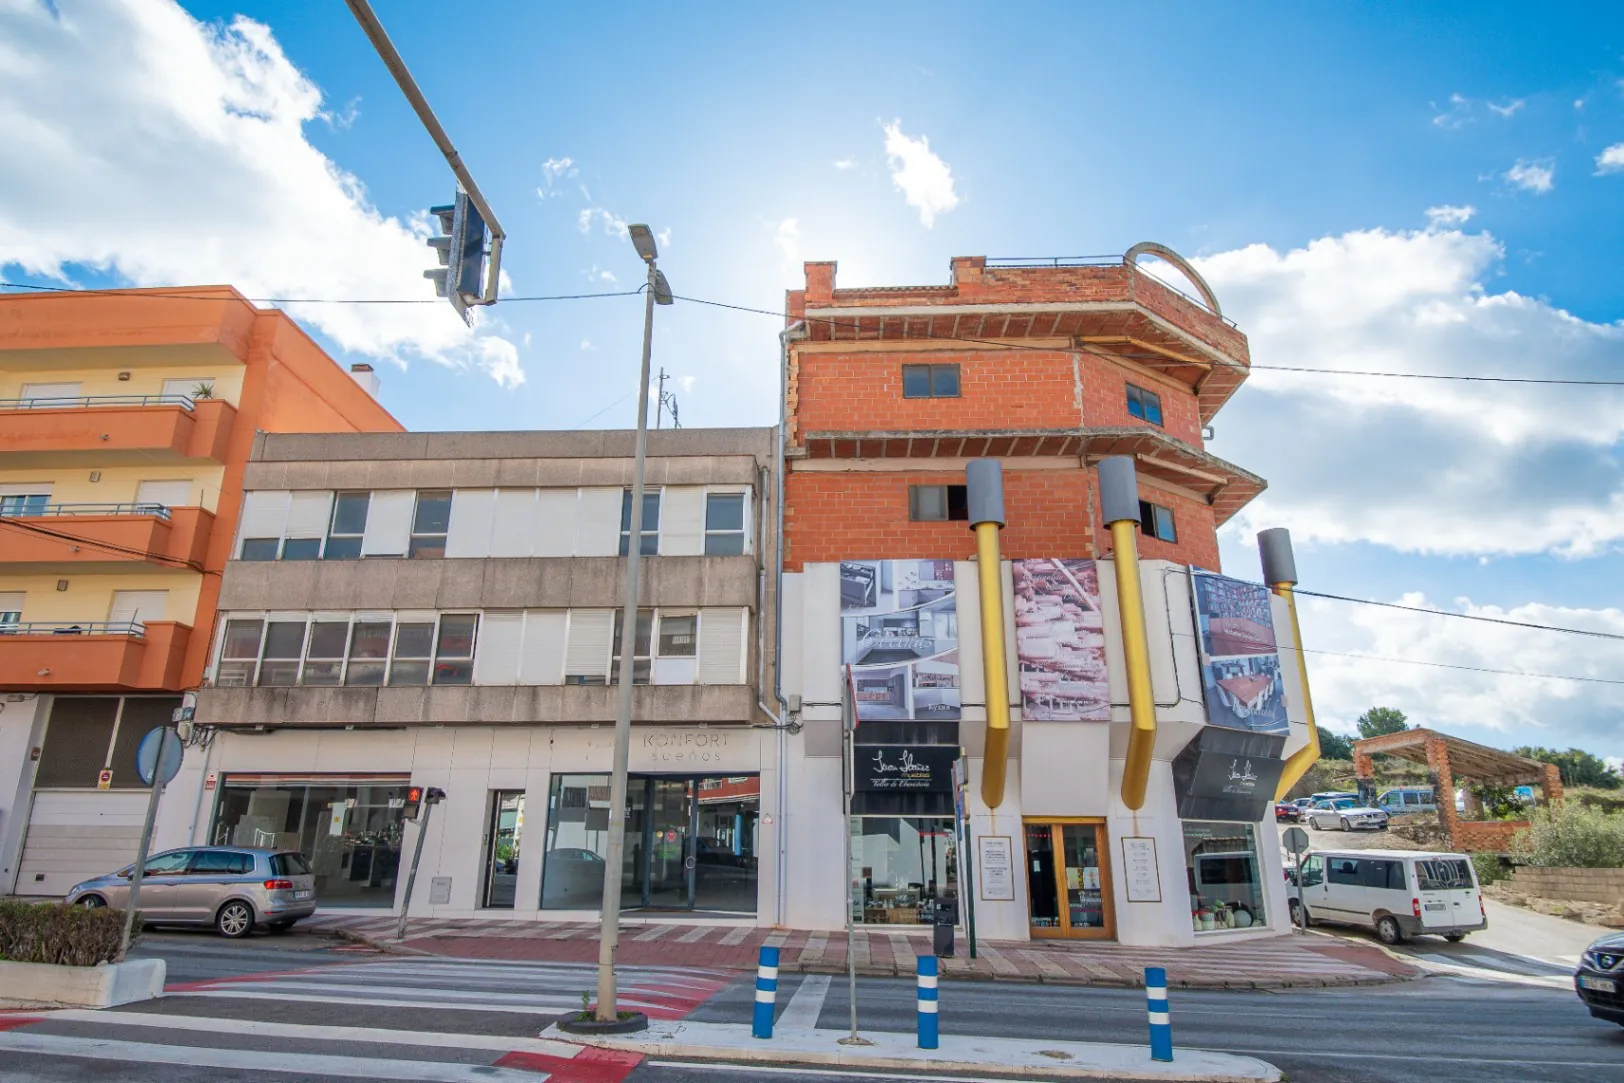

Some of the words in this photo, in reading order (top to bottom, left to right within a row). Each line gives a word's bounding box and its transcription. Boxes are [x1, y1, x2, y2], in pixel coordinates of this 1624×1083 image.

[643, 733, 730, 748] KONFORT
[652, 751, 721, 762] sueños
[872, 749, 898, 773] Juan
